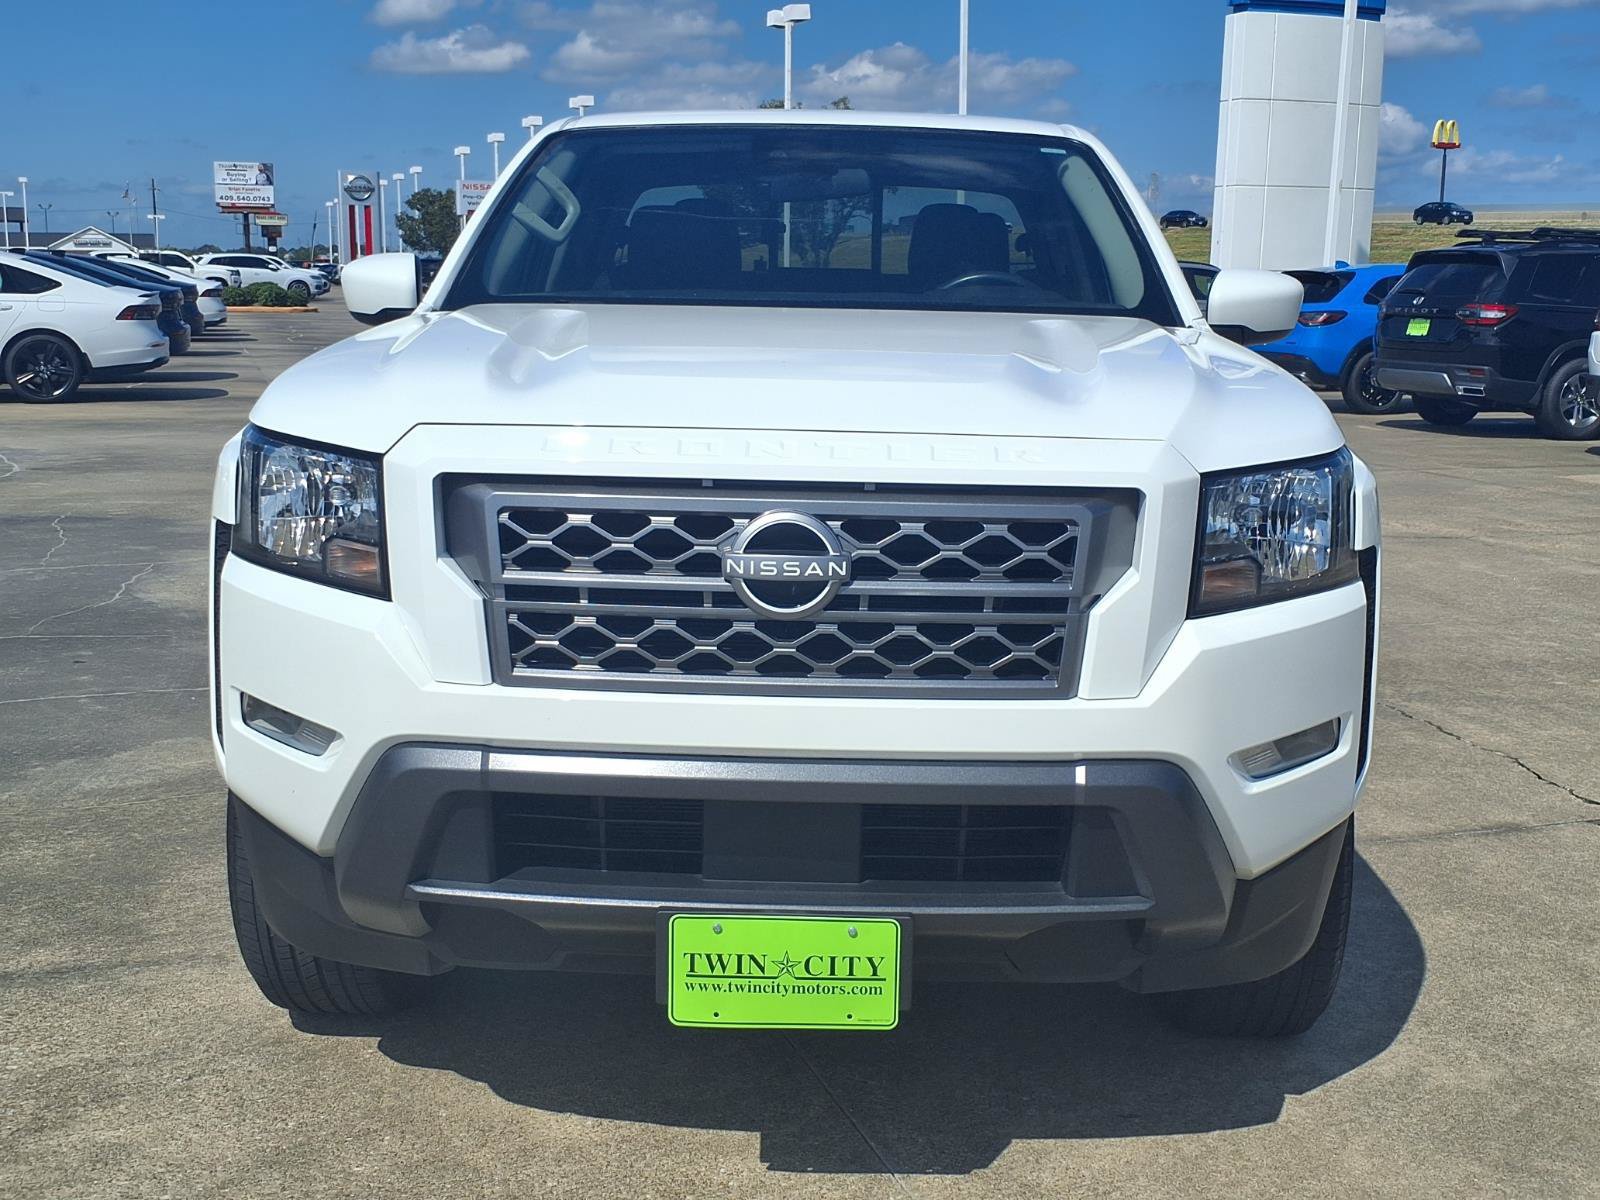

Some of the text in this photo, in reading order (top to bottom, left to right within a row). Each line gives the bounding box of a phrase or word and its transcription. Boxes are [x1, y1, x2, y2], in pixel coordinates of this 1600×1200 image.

[726, 559, 847, 577] NISSAN
[683, 952, 885, 977] TWIN CITY
[685, 981, 883, 997] www.twincitymotors.com
